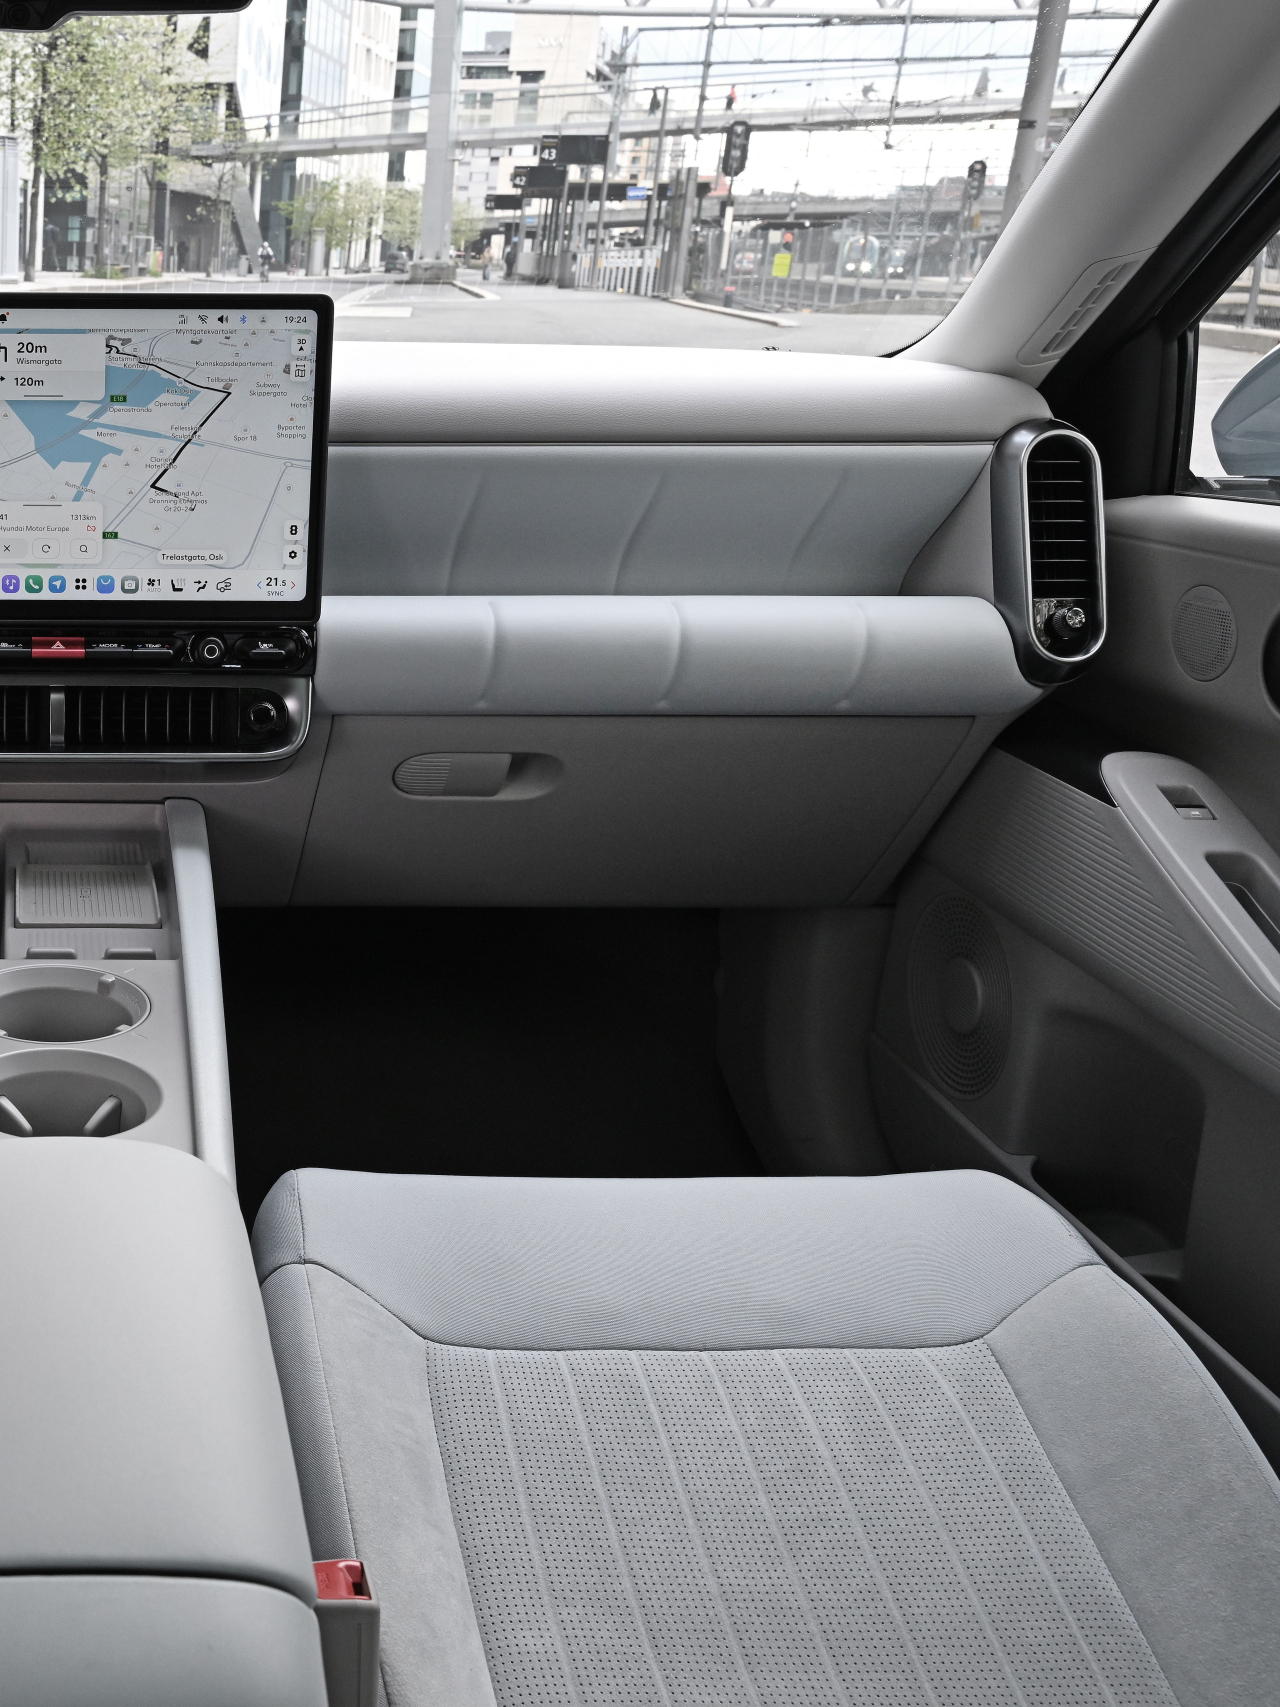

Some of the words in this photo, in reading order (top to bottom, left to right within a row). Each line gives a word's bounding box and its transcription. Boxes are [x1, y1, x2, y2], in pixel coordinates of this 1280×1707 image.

[541, 148, 557, 160] 43
[513, 176, 526, 186] 42
[284, 315, 307, 324] 19:24
[17, 342, 47, 354] 20m
[16, 357, 62, 366] Wismargata
[14, 377, 44, 387] 120m
[277, 424, 306, 432] Byporten
[276, 432, 307, 440] Shopping
[47, 525, 70, 533] Europe
[265, 576, 287, 587] 21.5
